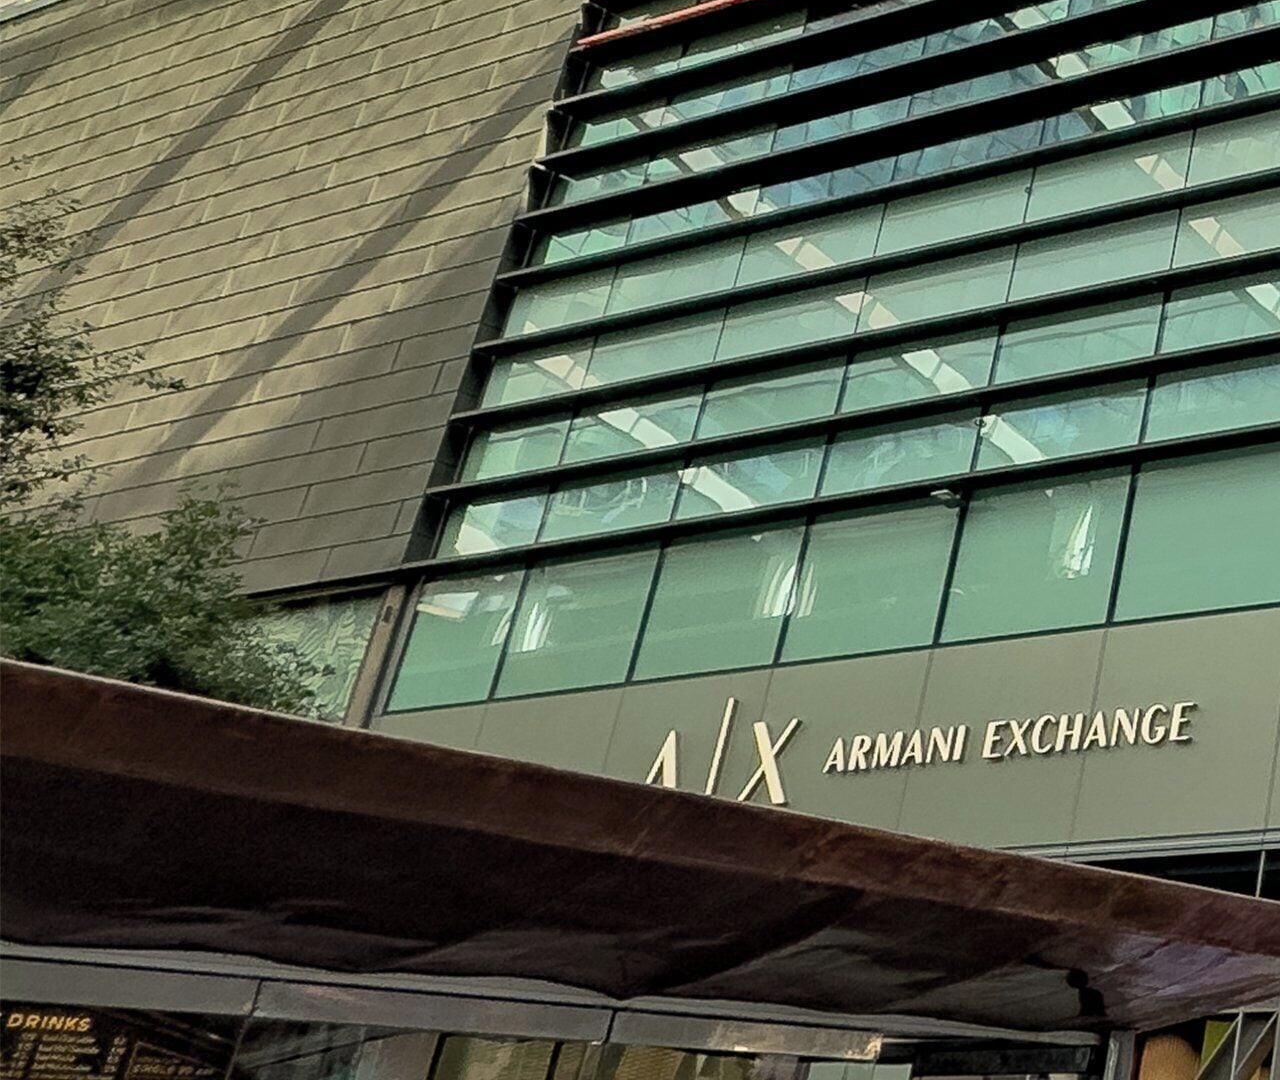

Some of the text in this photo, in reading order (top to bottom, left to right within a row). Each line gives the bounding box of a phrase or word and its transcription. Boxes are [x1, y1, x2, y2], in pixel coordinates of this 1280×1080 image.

[822, 724, 968, 774] ARMANI
[980, 701, 1199, 760] EXCHANGE
[6, 1013, 92, 1032] DRINKS
